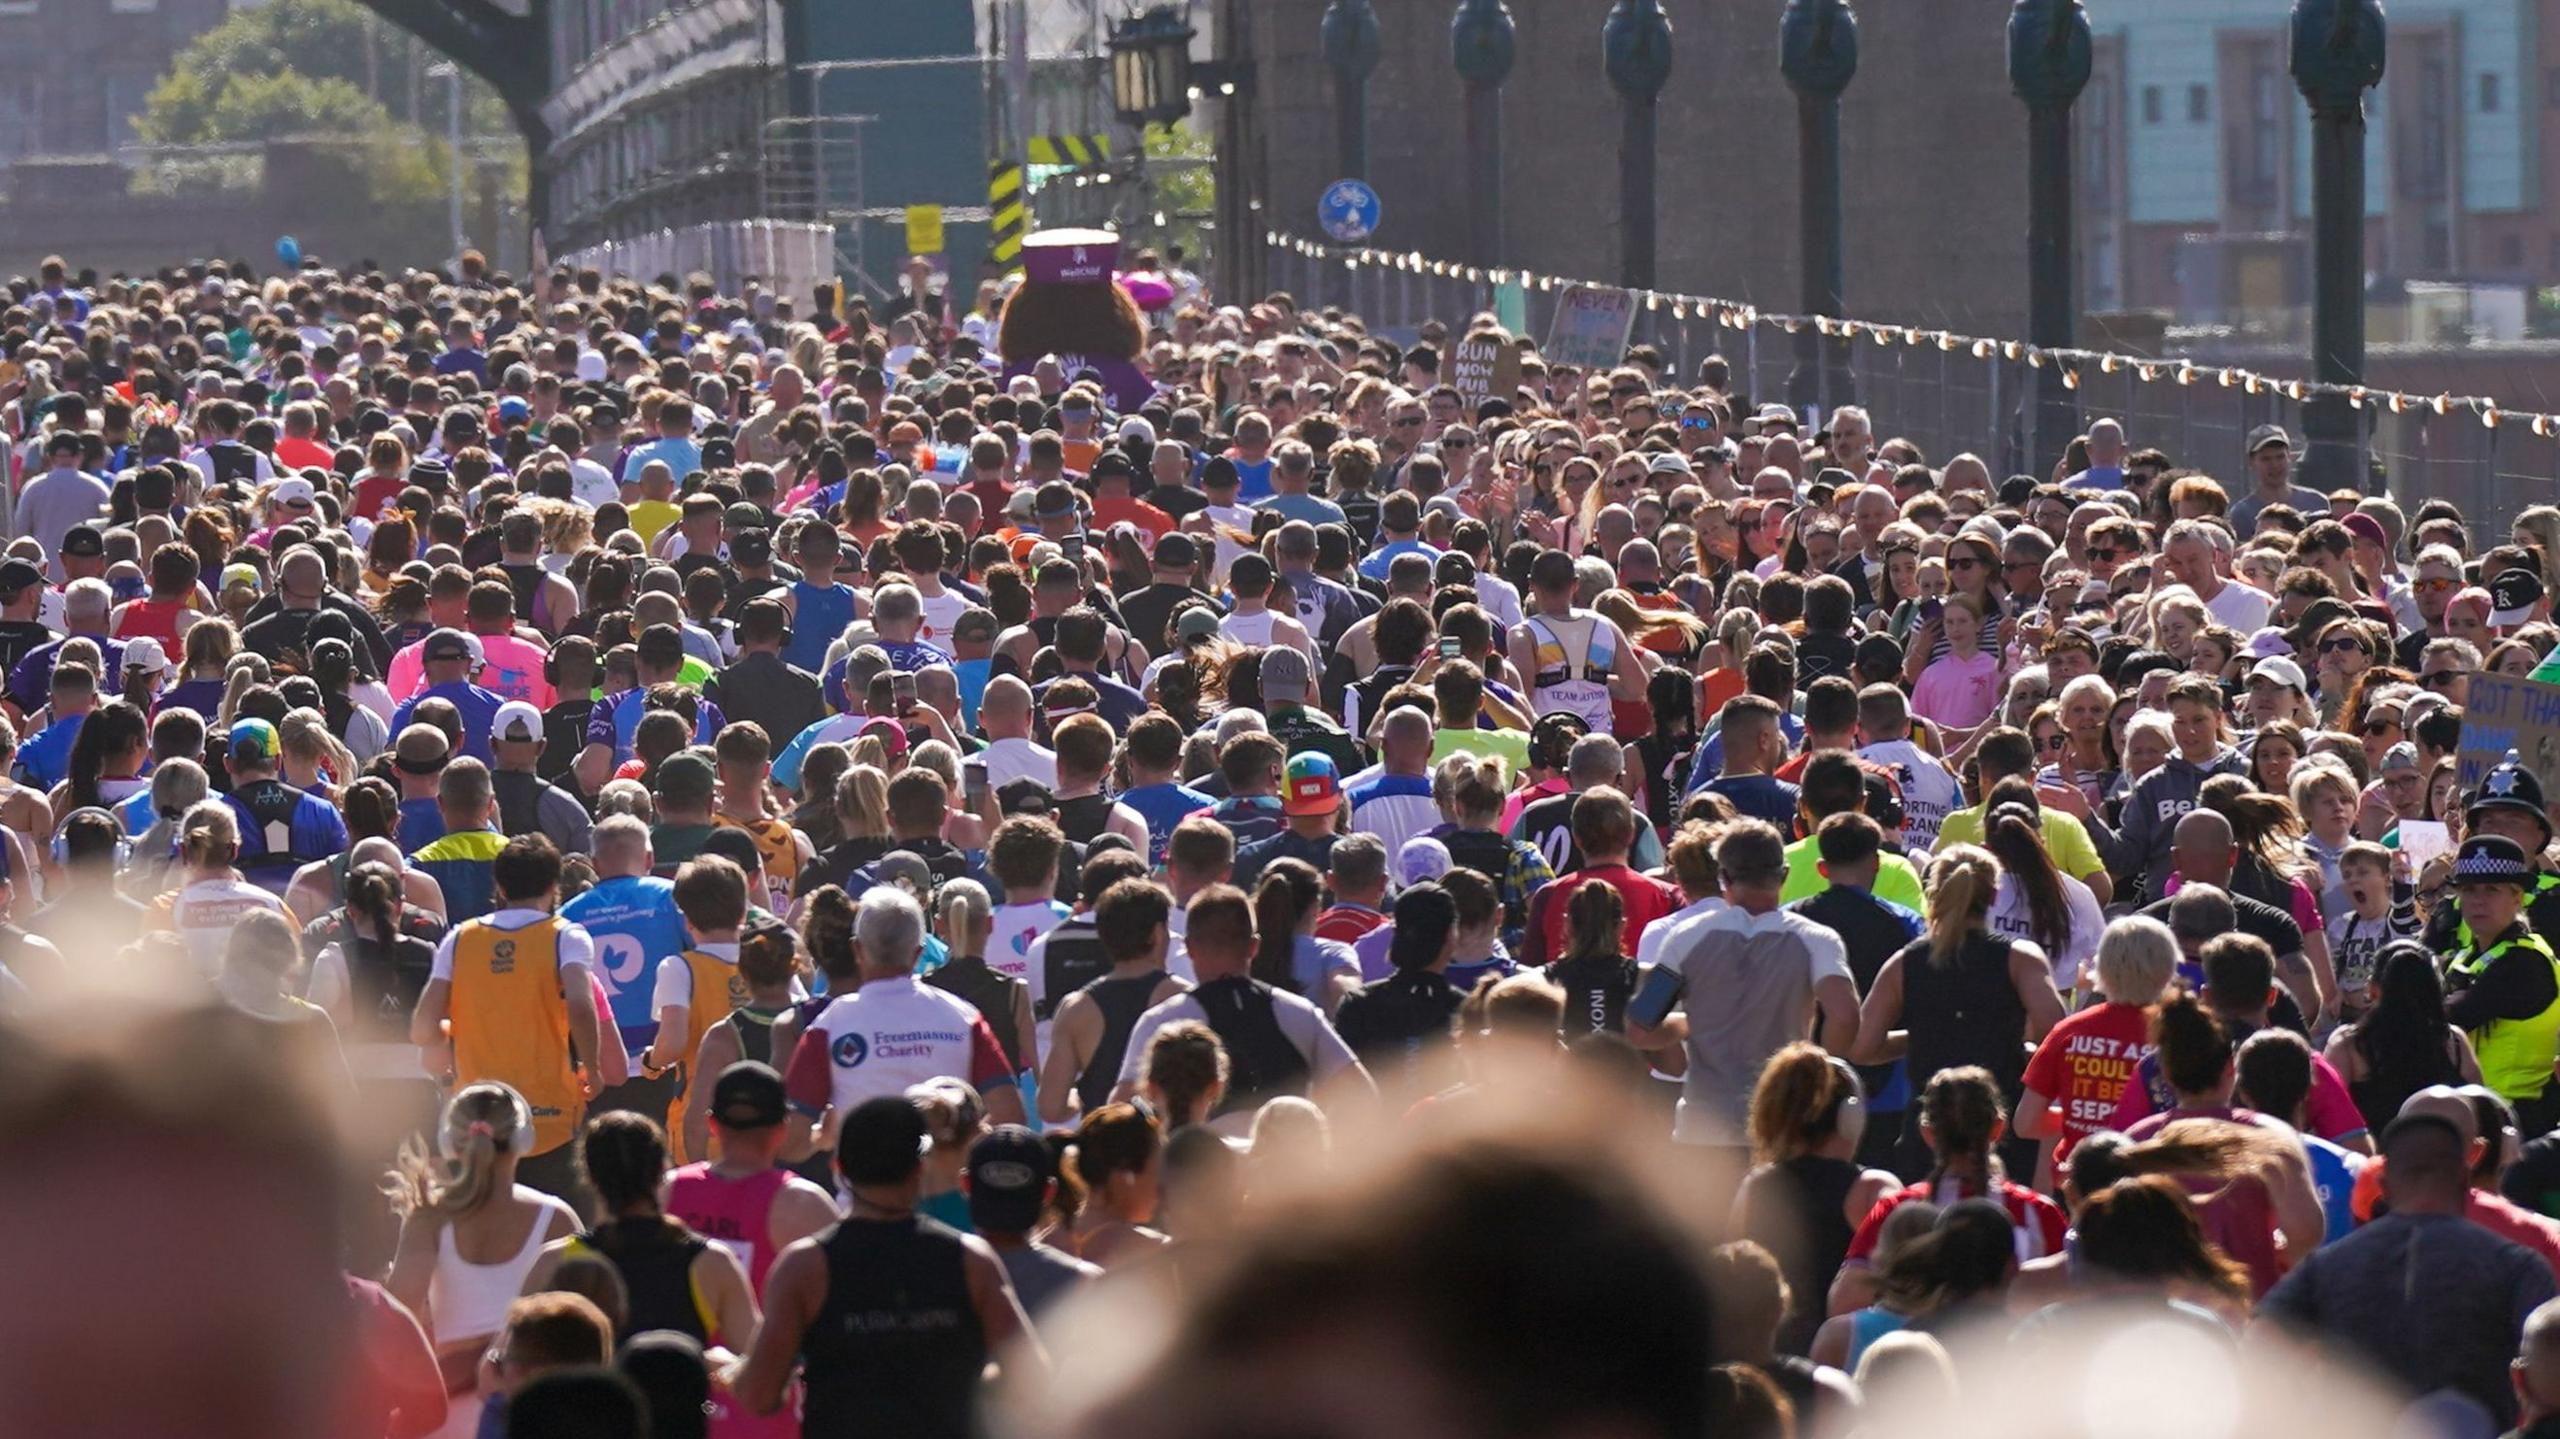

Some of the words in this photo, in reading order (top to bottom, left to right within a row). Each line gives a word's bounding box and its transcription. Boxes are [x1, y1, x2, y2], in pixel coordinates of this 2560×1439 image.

[1456, 342, 1497, 362] RUN
[1456, 378, 1489, 393] PUB
[1551, 690, 1578, 701] TEAM
[2469, 678, 2513, 718] GOT
[1994, 915, 2030, 935] run
[875, 1044, 934, 1059] Charity
[2065, 1035, 2121, 1057] JUST
[2064, 1054, 2132, 1081] "COUL
[2072, 1078, 2093, 1097] IT
[2071, 1099, 2118, 1121] SEP
